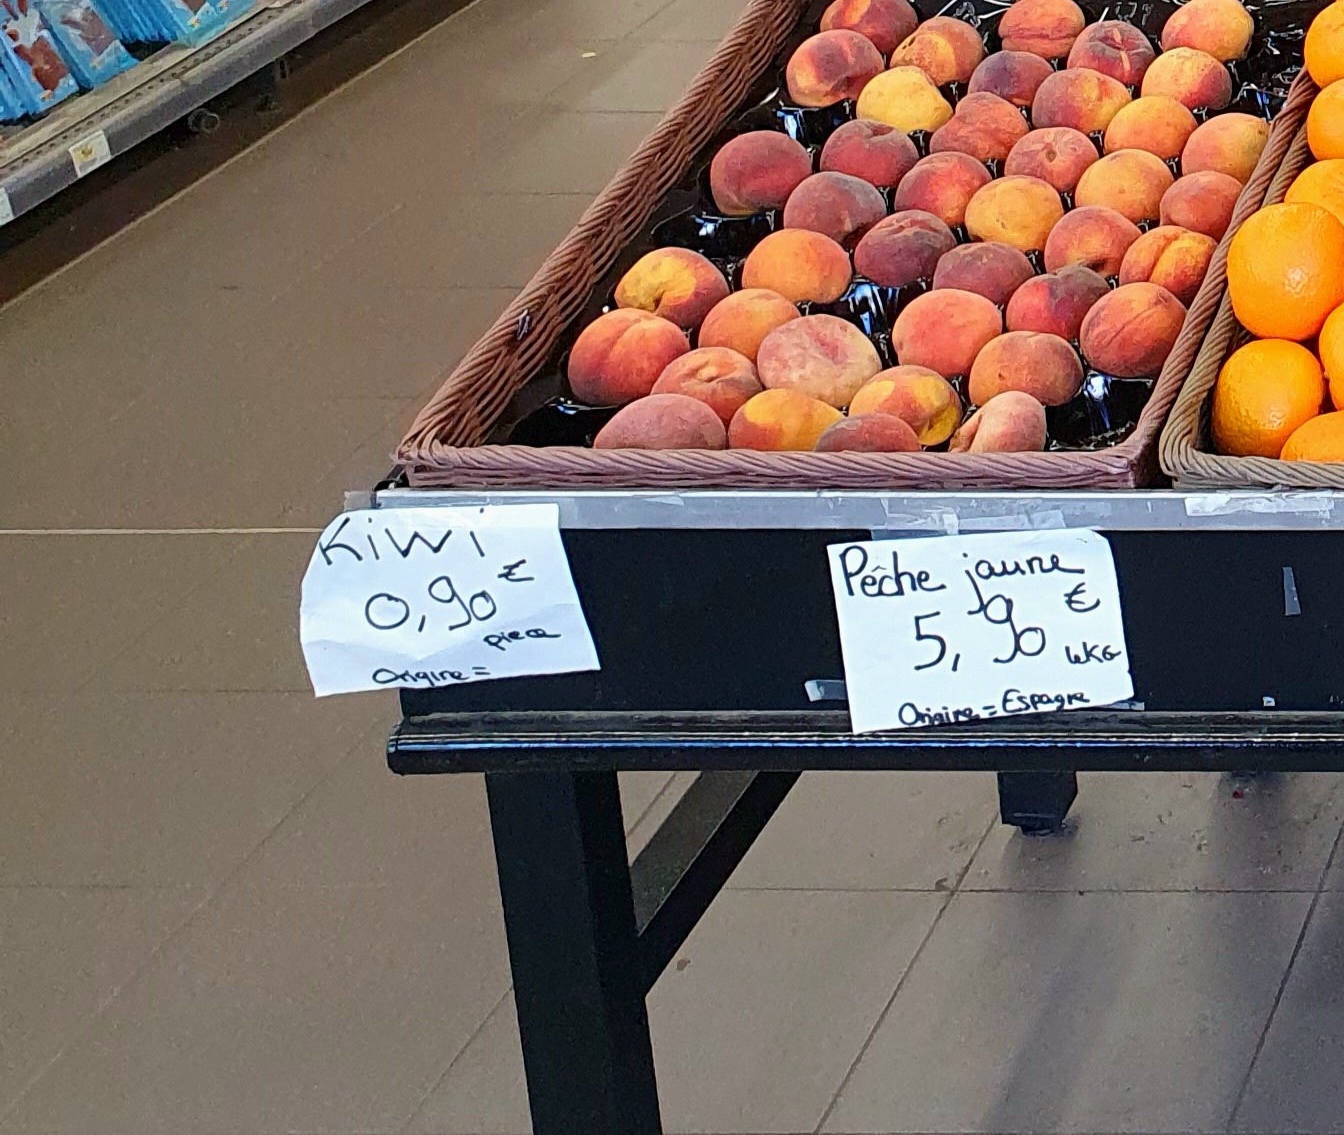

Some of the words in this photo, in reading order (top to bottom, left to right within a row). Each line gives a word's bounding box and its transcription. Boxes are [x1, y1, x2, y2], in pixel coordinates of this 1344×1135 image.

[319, 507, 486, 565] Kiwi
[839, 545, 947, 597] Pêche
[962, 552, 1085, 615] jaune
